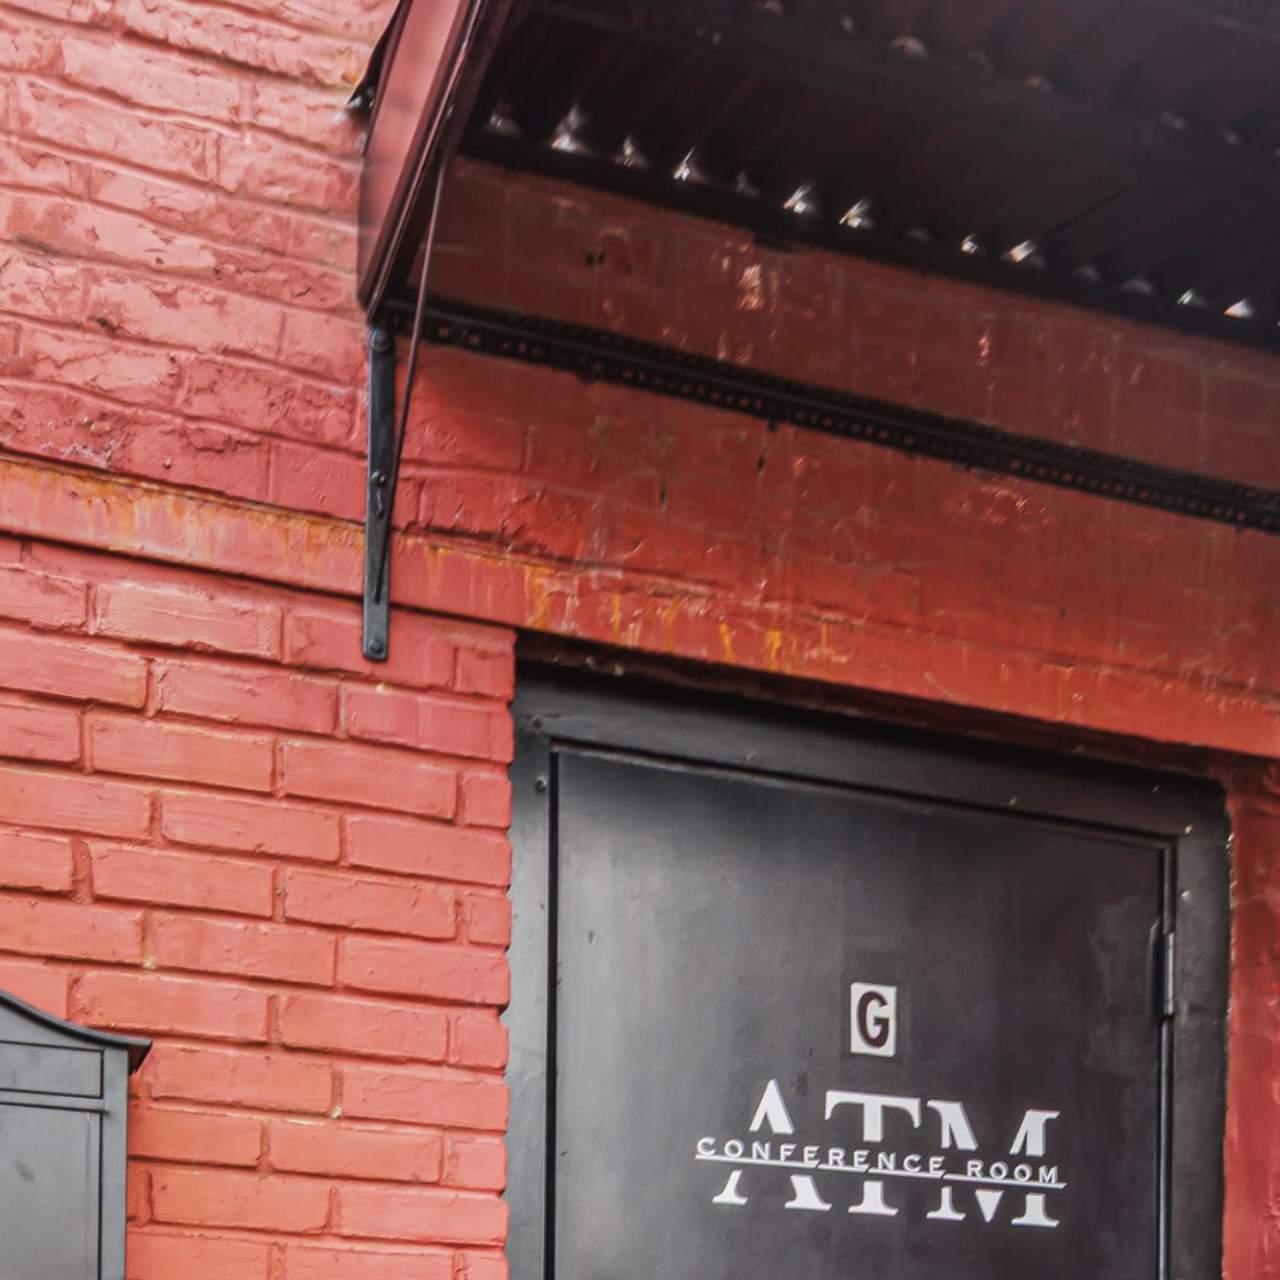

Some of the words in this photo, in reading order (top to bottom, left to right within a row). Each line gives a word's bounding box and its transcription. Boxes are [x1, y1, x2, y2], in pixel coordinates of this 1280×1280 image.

[856, 989, 890, 1049] G
[696, 1136, 947, 1175] CONFERENCE
[966, 1159, 1060, 1185] ROOM
[712, 1078, 1061, 1228] ATM
